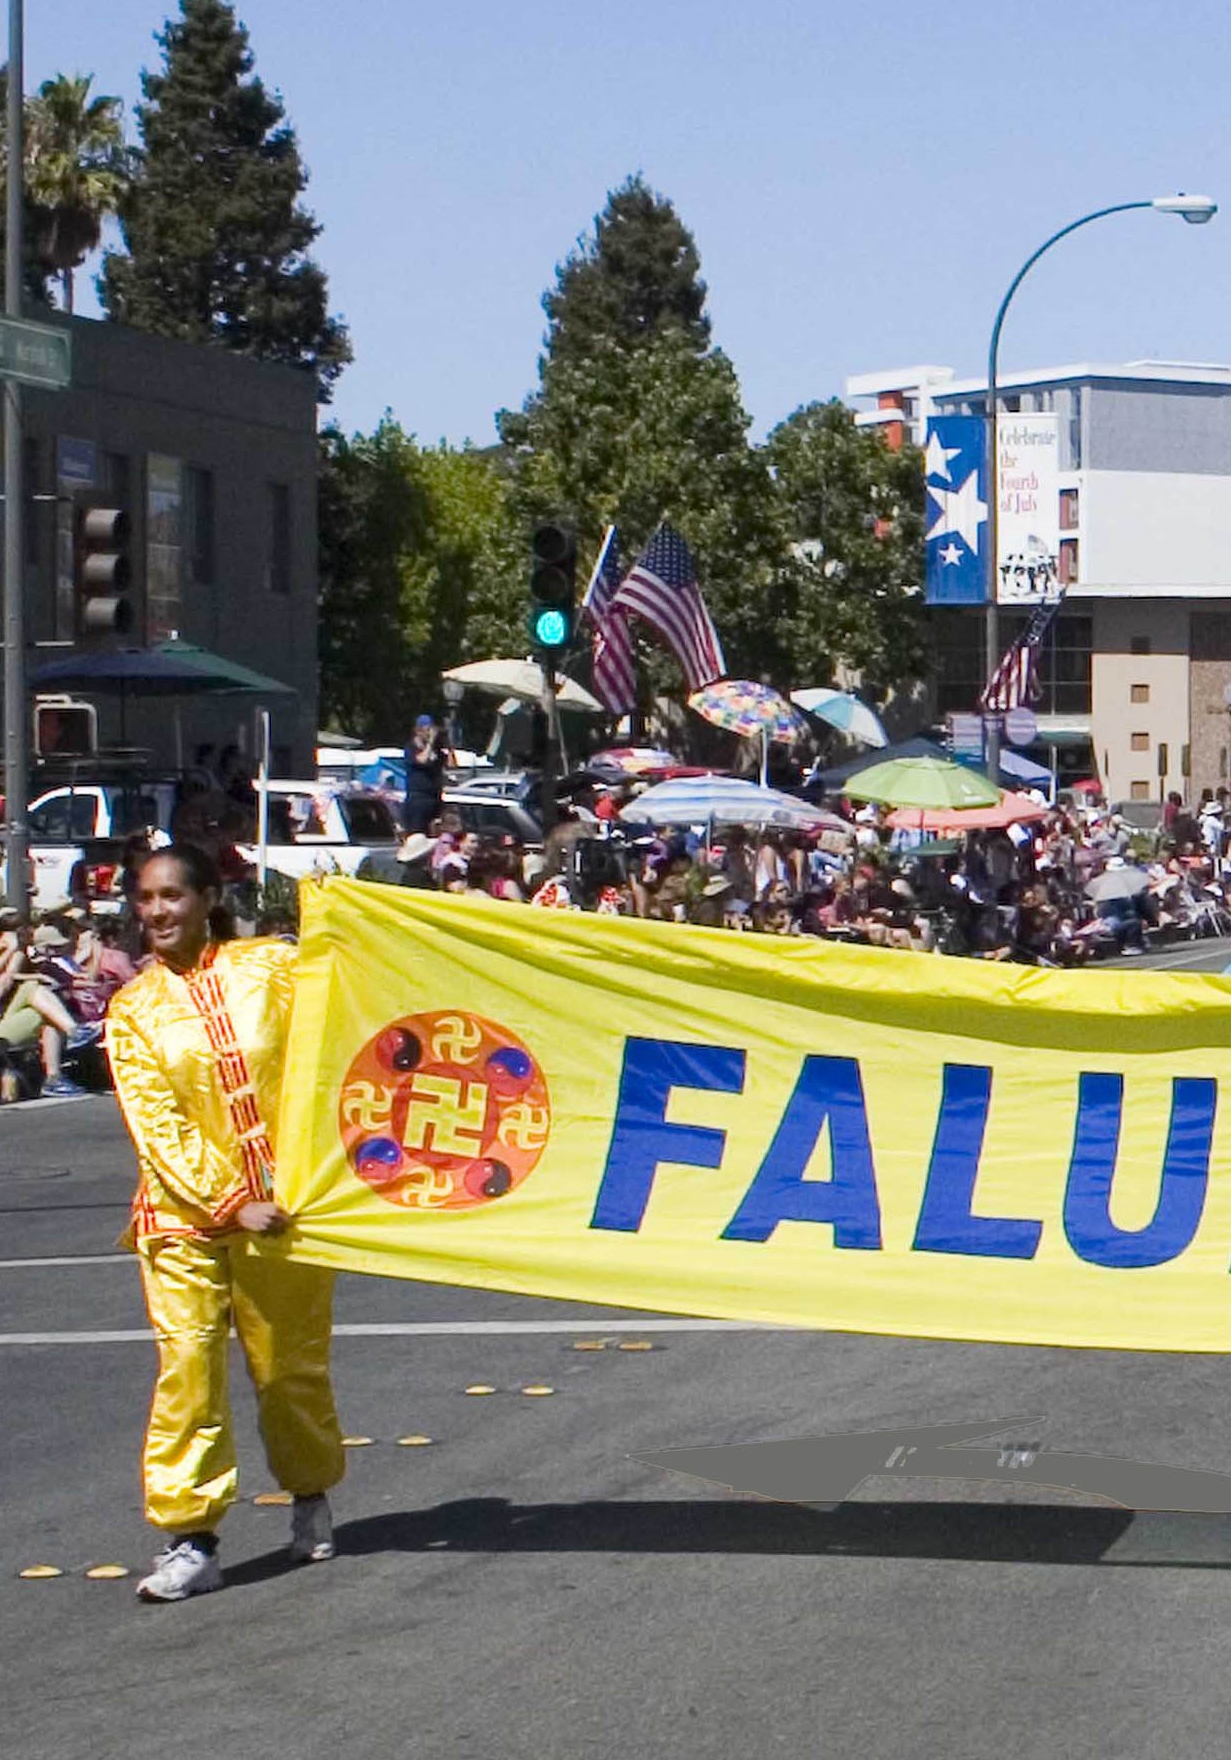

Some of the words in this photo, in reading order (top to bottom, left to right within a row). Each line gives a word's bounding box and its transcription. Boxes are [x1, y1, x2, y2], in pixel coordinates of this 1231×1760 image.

[1000, 426, 1056, 446] Celebrate
[1000, 449, 1018, 468] the
[1000, 471, 1038, 491] Fourth
[1001, 493, 1013, 512] of
[1015, 492, 1038, 517] July
